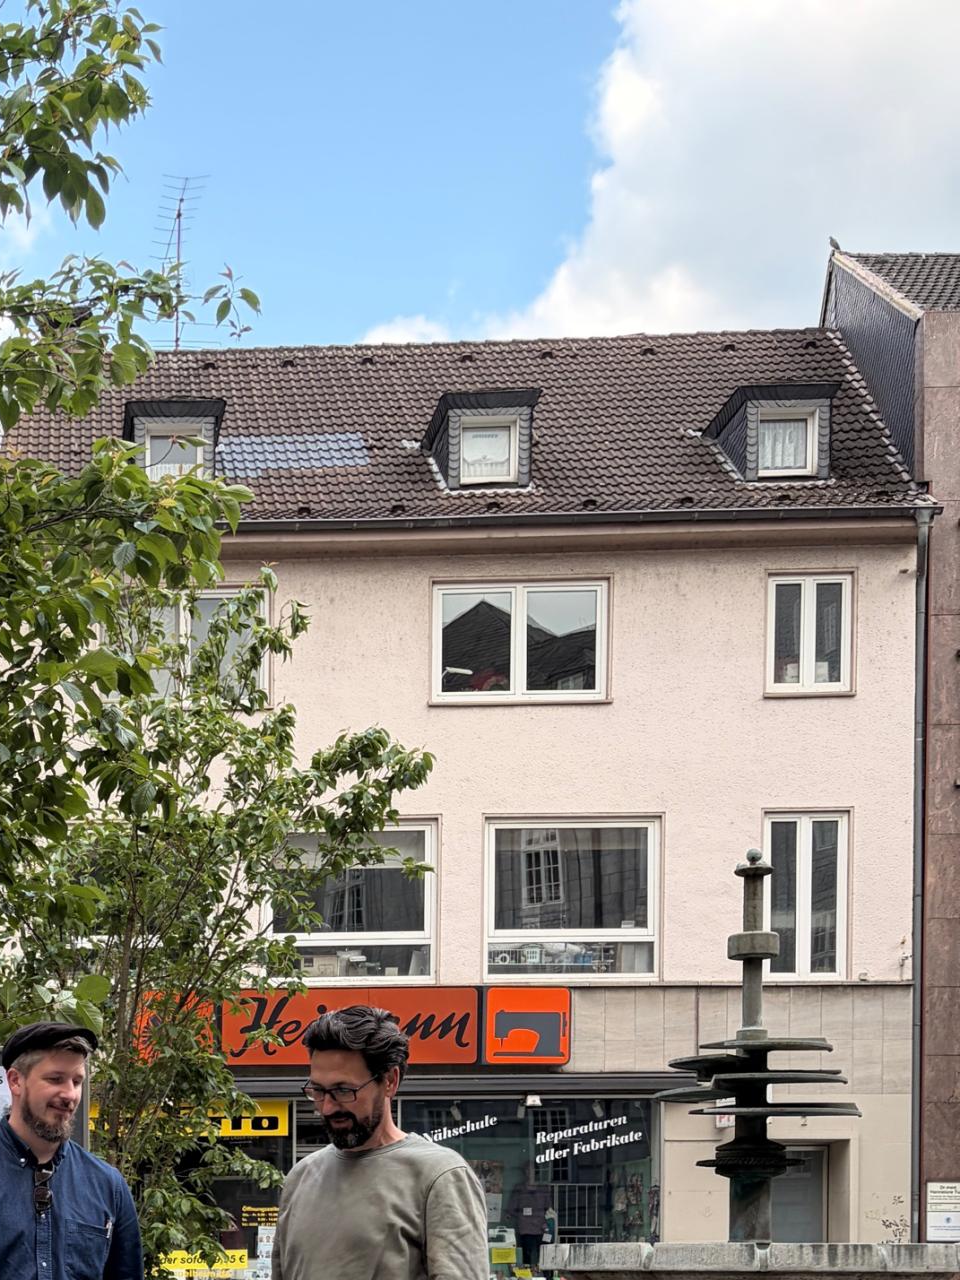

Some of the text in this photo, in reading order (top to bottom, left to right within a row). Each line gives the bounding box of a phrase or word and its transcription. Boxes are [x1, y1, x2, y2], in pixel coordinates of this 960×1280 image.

[422, 1115, 498, 1143] Nähschule
[536, 1115, 628, 1145] Reparaturen
[535, 1130, 643, 1165] aller Fabrikate
